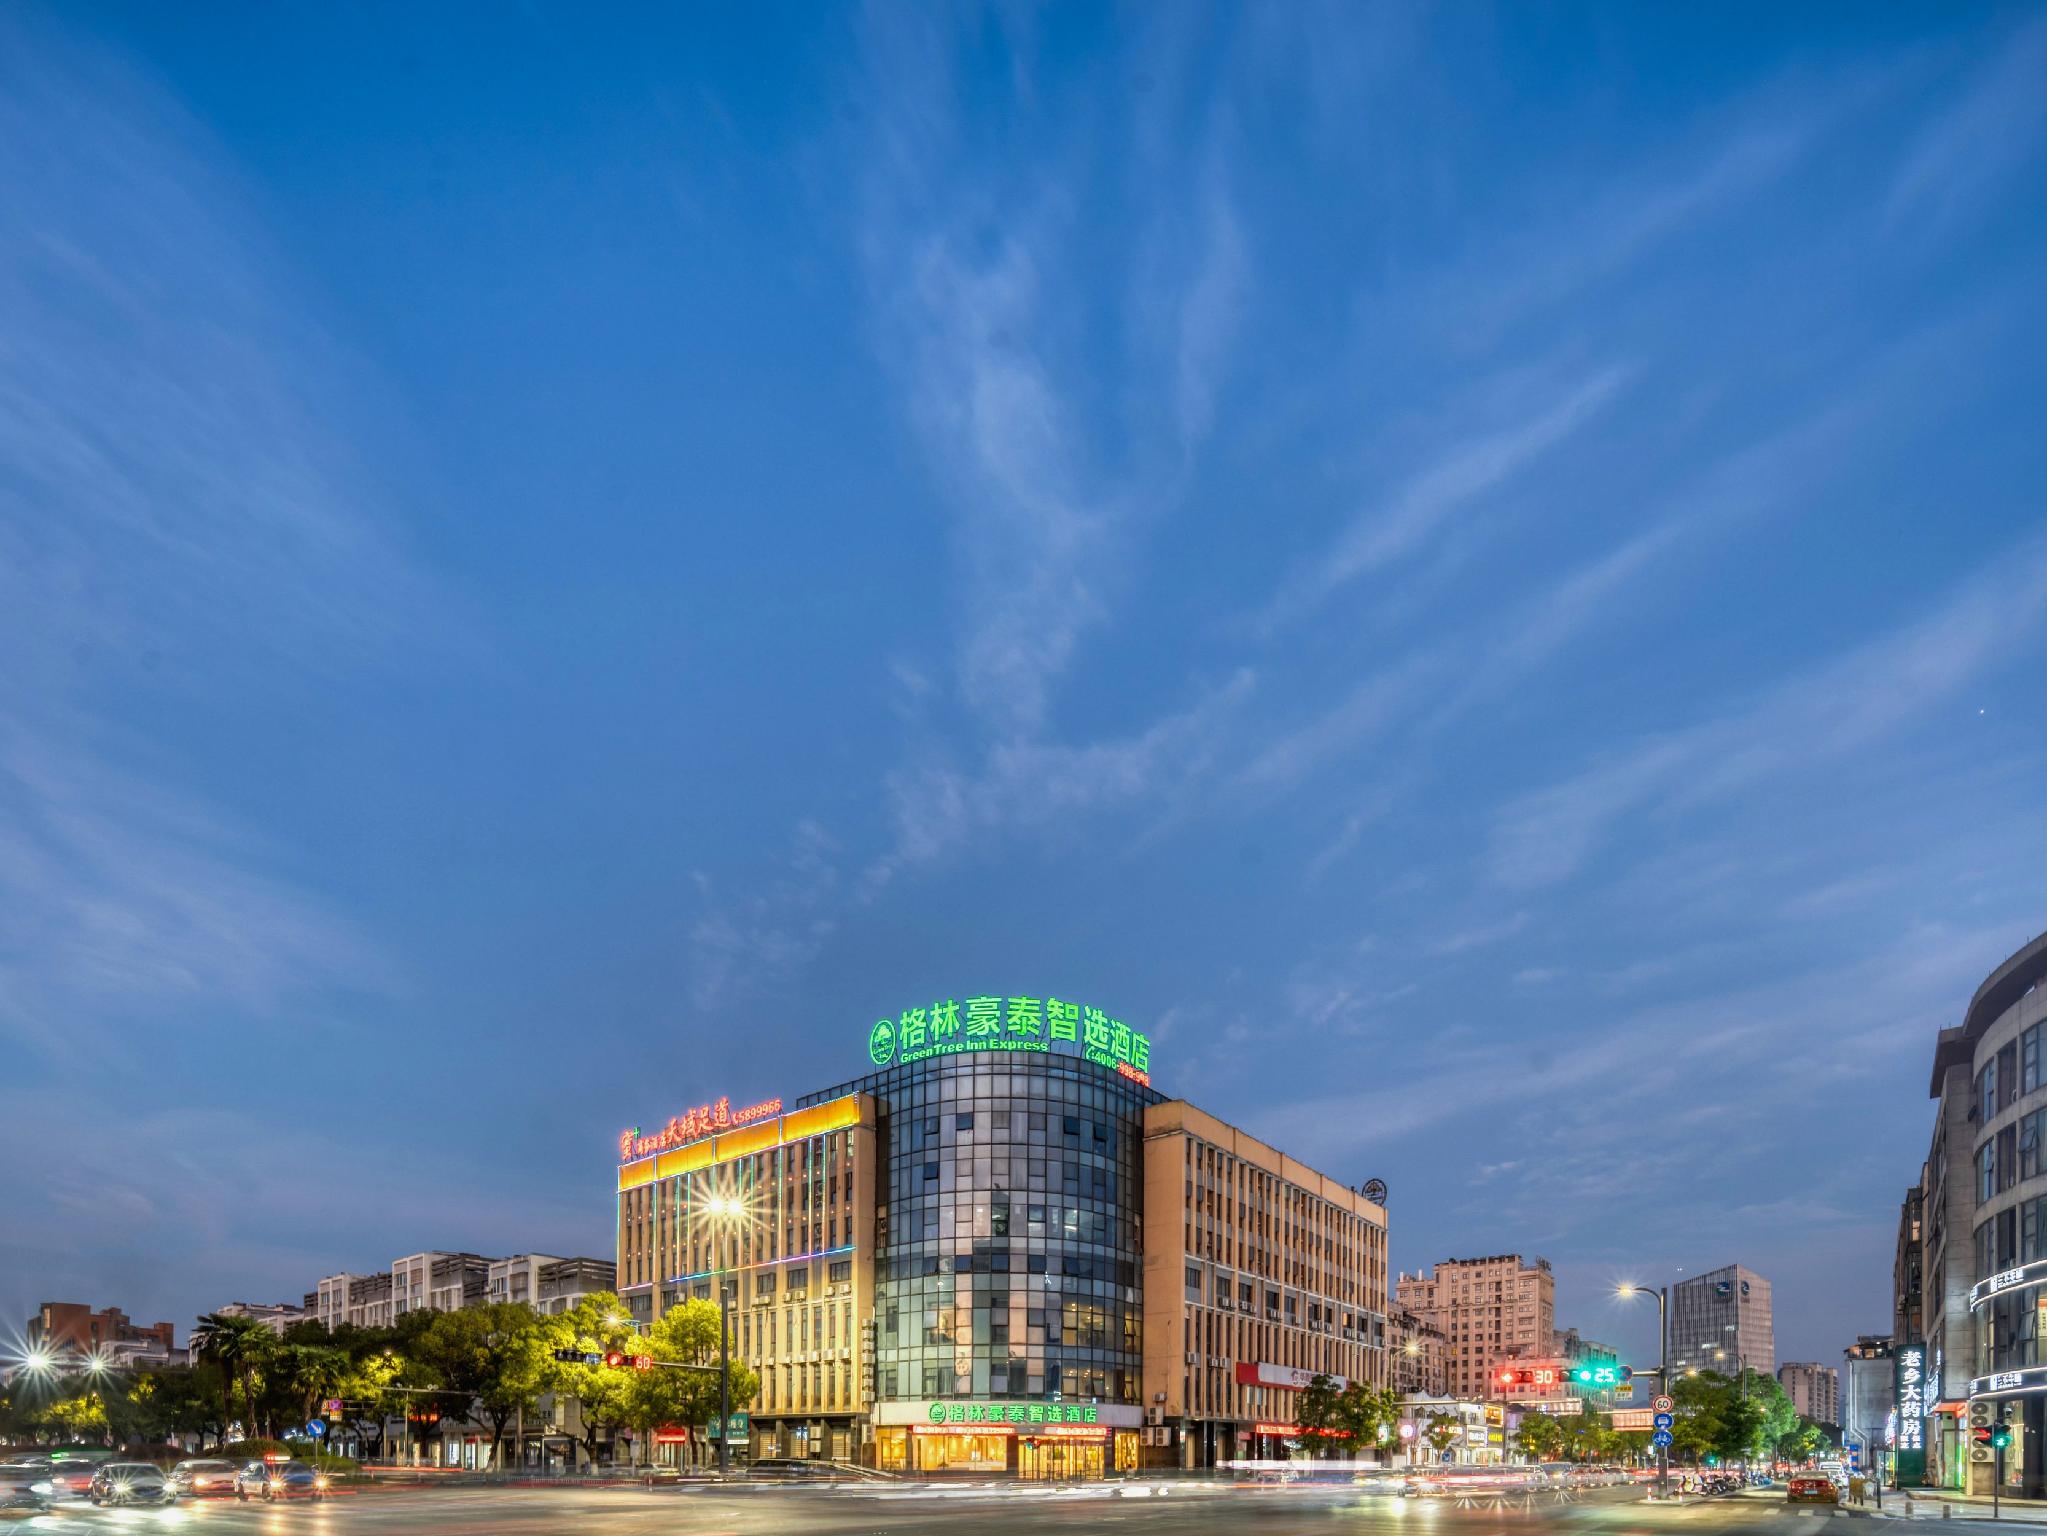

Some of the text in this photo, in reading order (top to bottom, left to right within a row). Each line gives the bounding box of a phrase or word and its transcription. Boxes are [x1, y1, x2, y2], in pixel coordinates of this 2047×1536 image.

[900, 996, 1150, 1073] 格林豪泰智选酒店
[966, 1039, 987, 1050] Inn
[989, 1038, 1049, 1051] Express
[1535, 1370, 1553, 1384] 30
[1594, 1368, 1613, 1383] 25
[1657, 1400, 1669, 1409] 60
[949, 1404, 1098, 1423] 格林豪泰智选酒店
